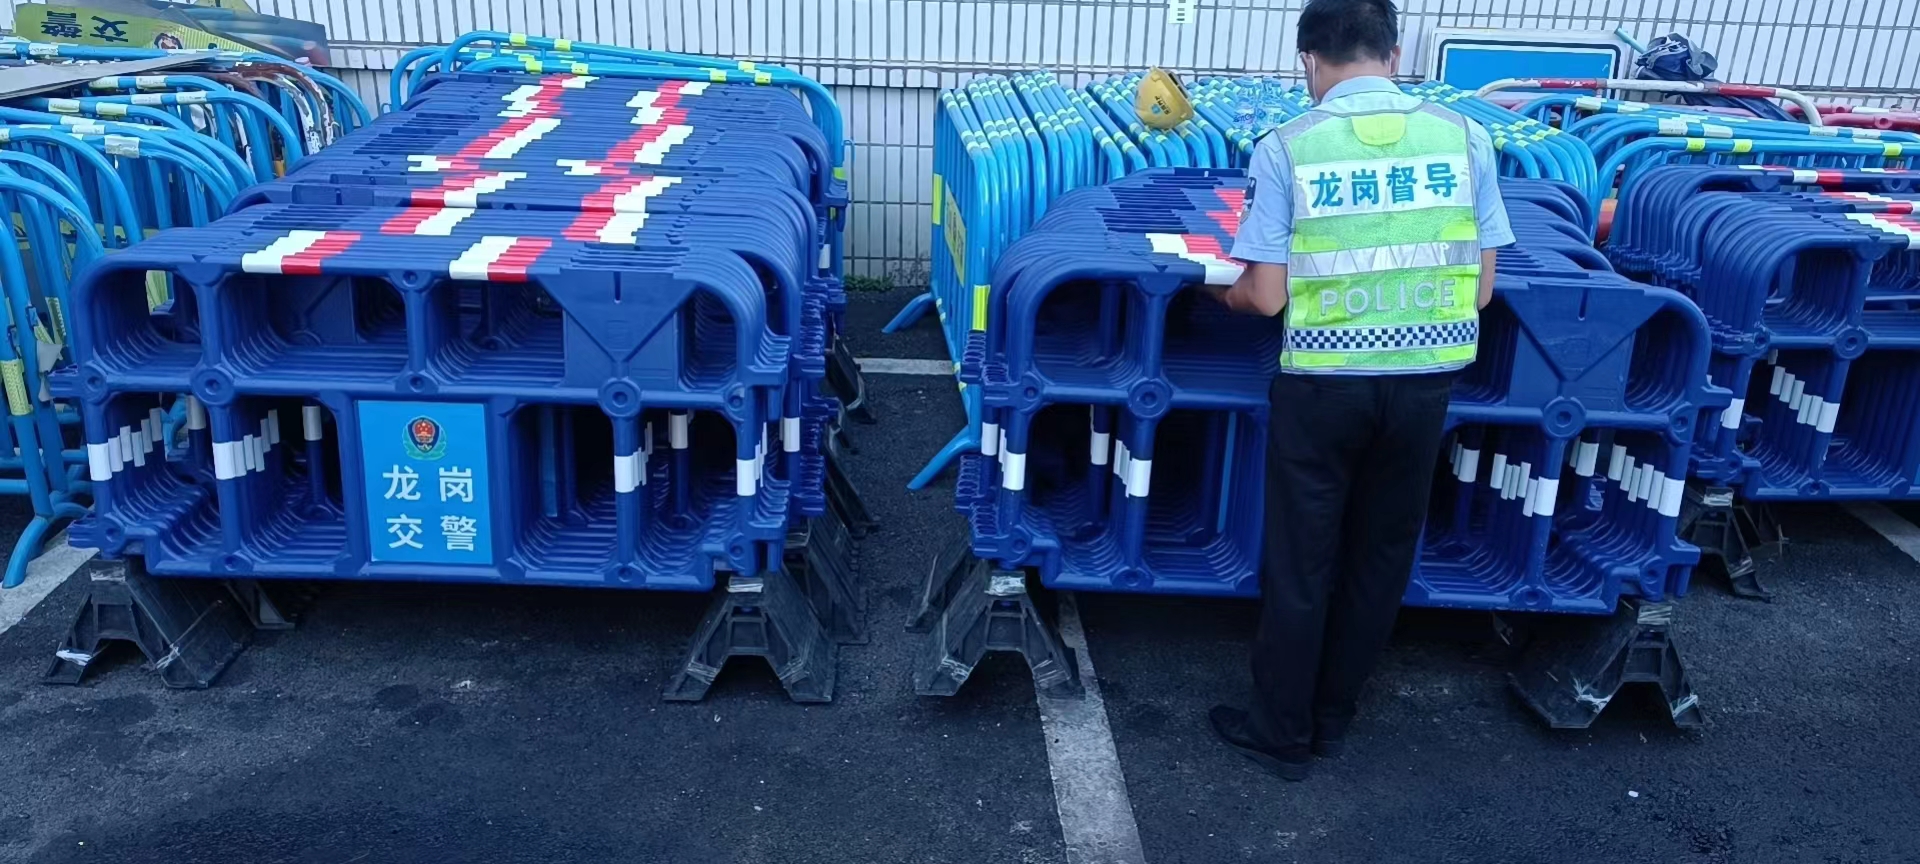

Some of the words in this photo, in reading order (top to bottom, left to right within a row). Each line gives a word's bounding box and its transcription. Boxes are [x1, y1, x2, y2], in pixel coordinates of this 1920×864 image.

[41, 10, 128, 42] 交警
[1309, 163, 1458, 208] 龙岗督导
[1320, 278, 1455, 316] POLICE
[382, 464, 474, 503] 龙岗
[386, 514, 477, 552] 交警
